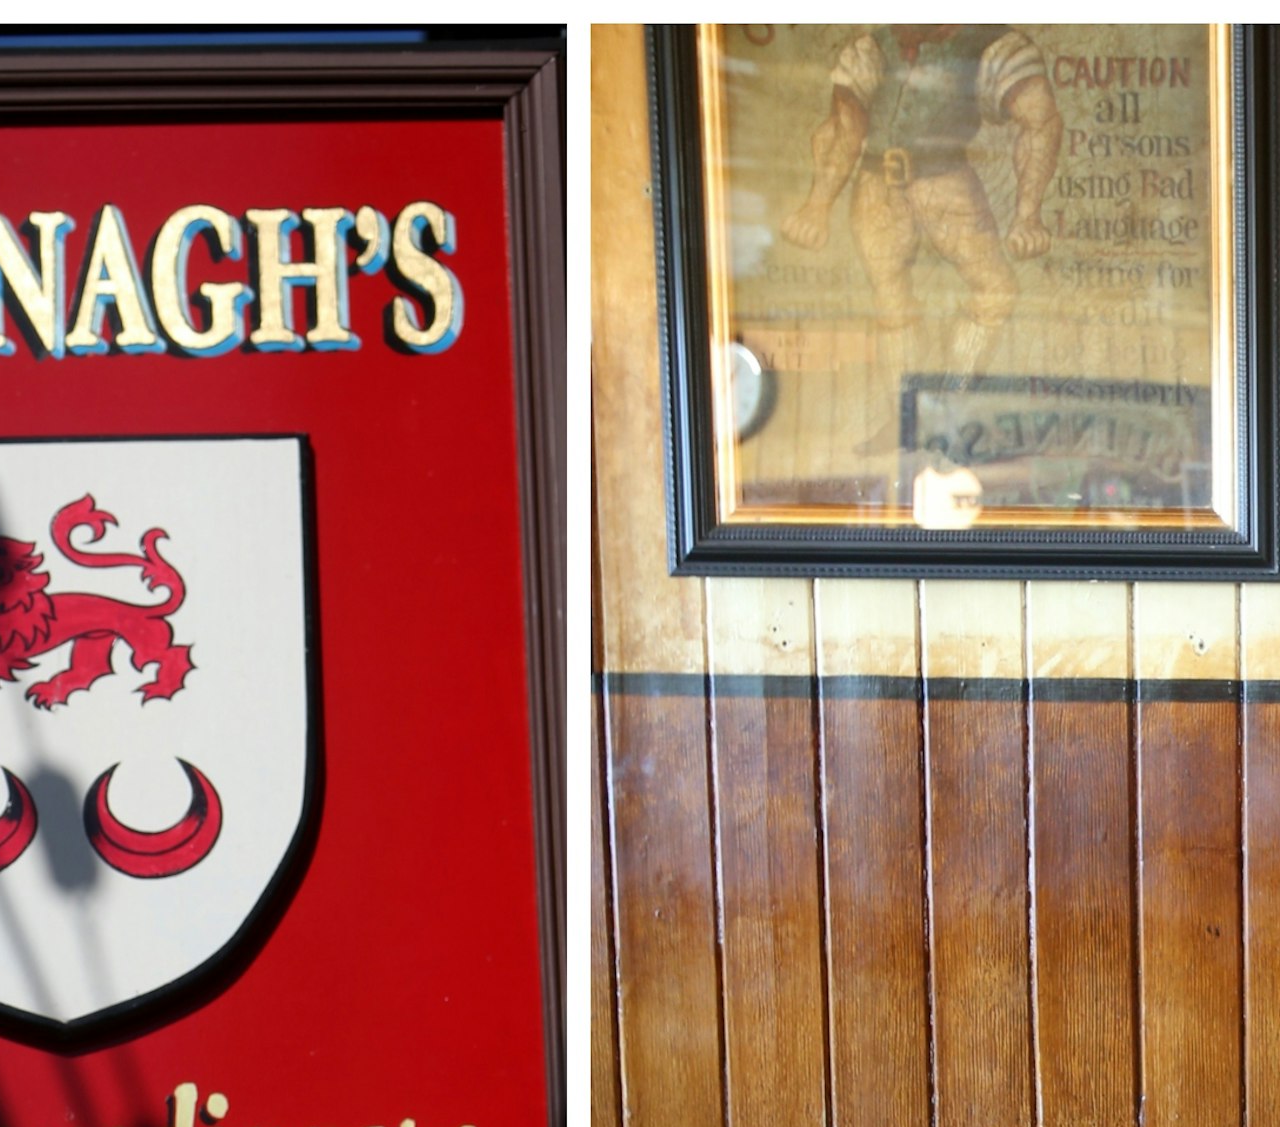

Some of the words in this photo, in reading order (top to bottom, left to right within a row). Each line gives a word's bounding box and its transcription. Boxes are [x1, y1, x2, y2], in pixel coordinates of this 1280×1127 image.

[1053, 55, 1192, 89] CAUTION
[1095, 91, 1141, 124] all
[1066, 128, 1191, 157] Persons
[1057, 171, 1132, 207] using
[1138, 168, 1194, 200] Bad
[1054, 209, 1200, 246] Language
[1156, 260, 1200, 289] for
